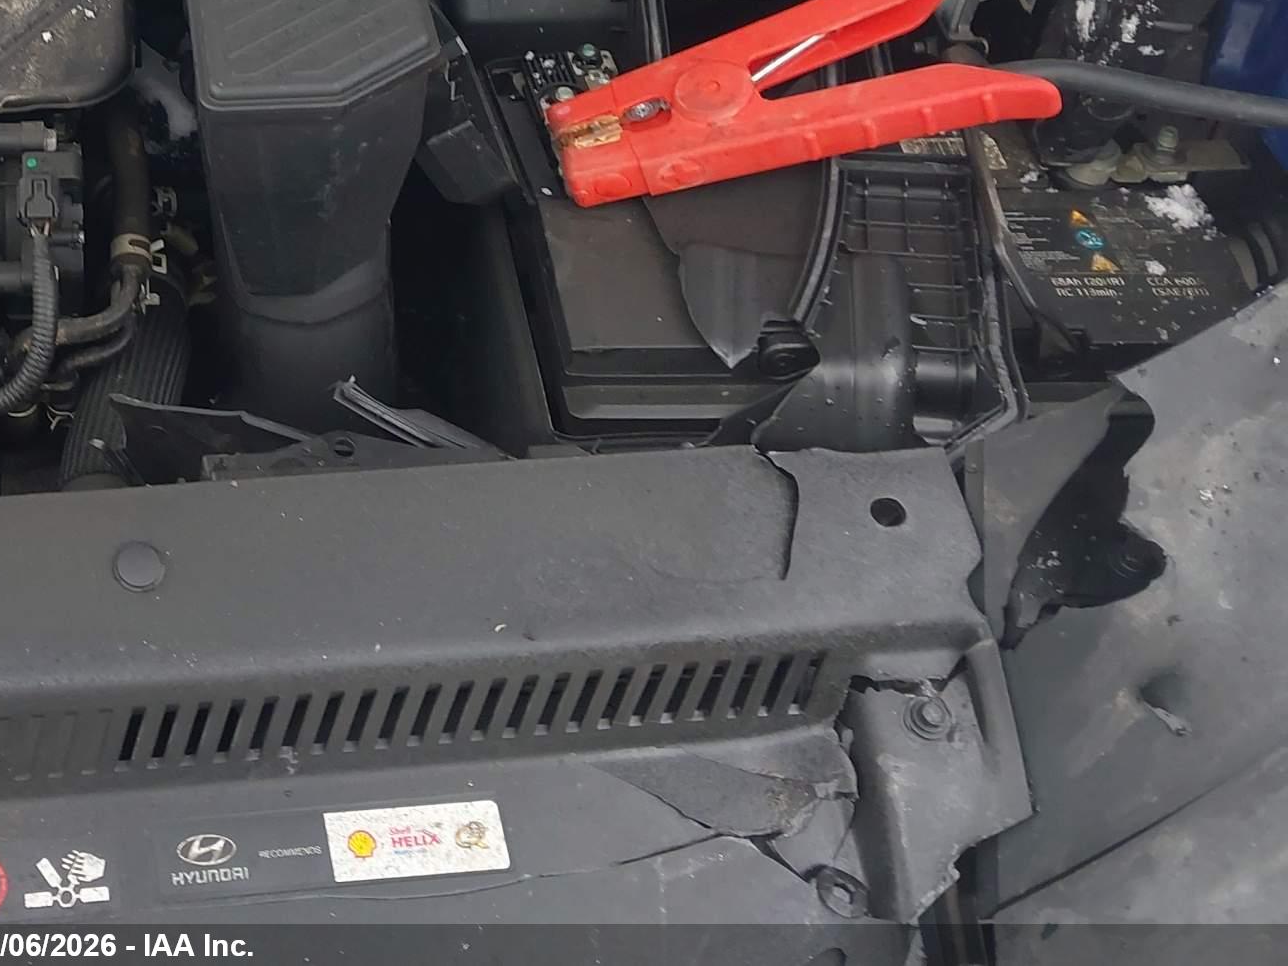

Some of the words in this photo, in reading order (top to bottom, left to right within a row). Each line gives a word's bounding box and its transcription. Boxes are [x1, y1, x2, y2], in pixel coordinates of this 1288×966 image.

[388, 825, 413, 836] Shell
[391, 833, 442, 849] HELIX
[170, 866, 249, 886] HYUNDAI
